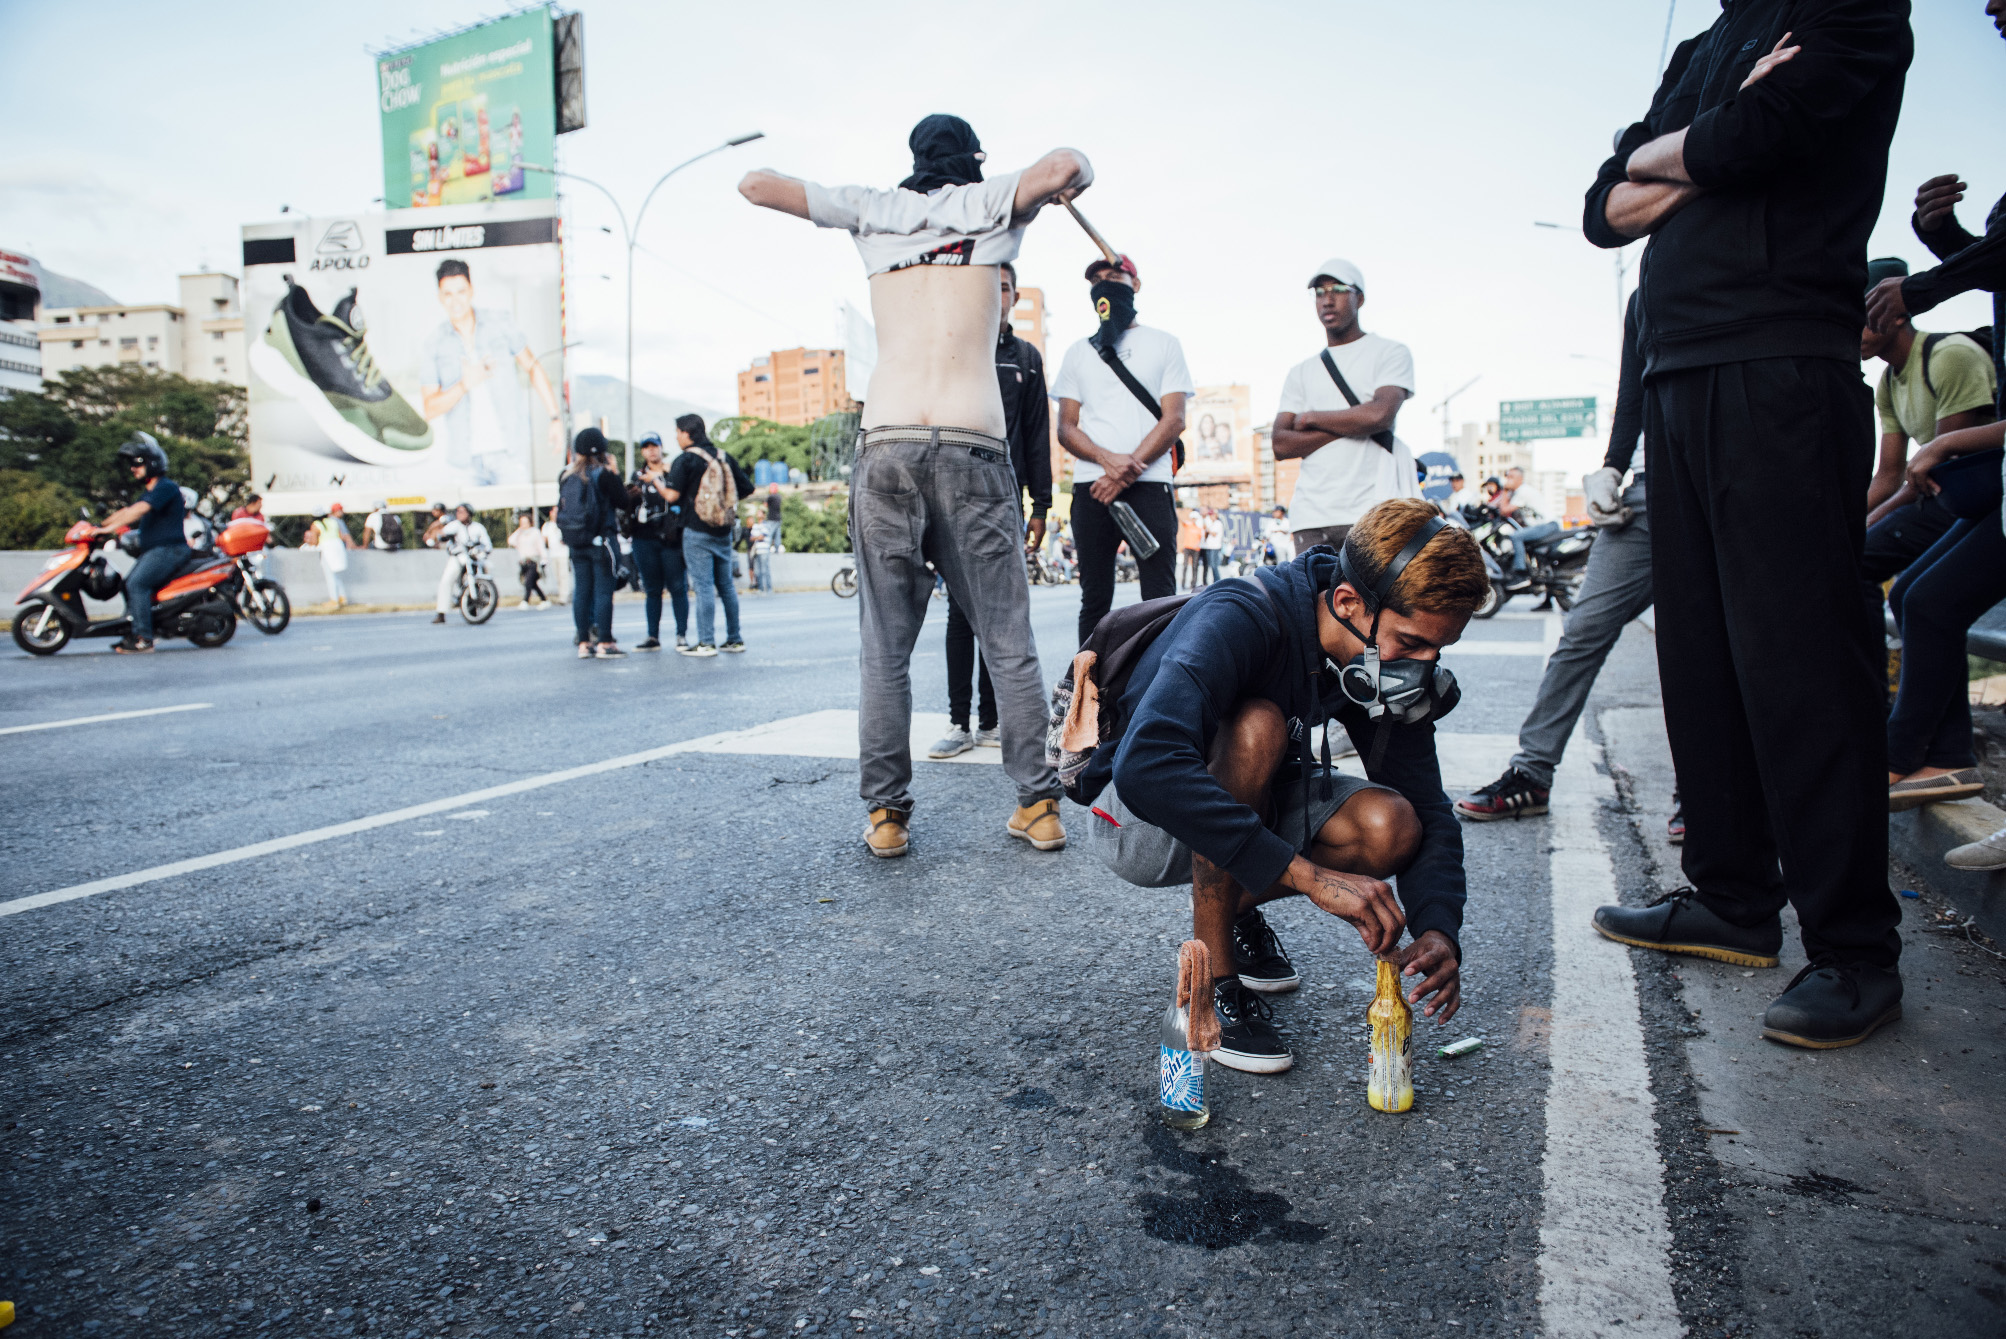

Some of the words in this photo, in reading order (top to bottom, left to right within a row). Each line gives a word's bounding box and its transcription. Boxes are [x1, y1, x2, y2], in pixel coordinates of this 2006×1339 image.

[381, 68, 412, 91] DOG
[381, 83, 422, 113] CHOW
[412, 229, 435, 251] SIN
[435, 225, 486, 249] LÍMITES
[310, 256, 370, 271] APOLO
[1160, 1055, 1182, 1098] Light
